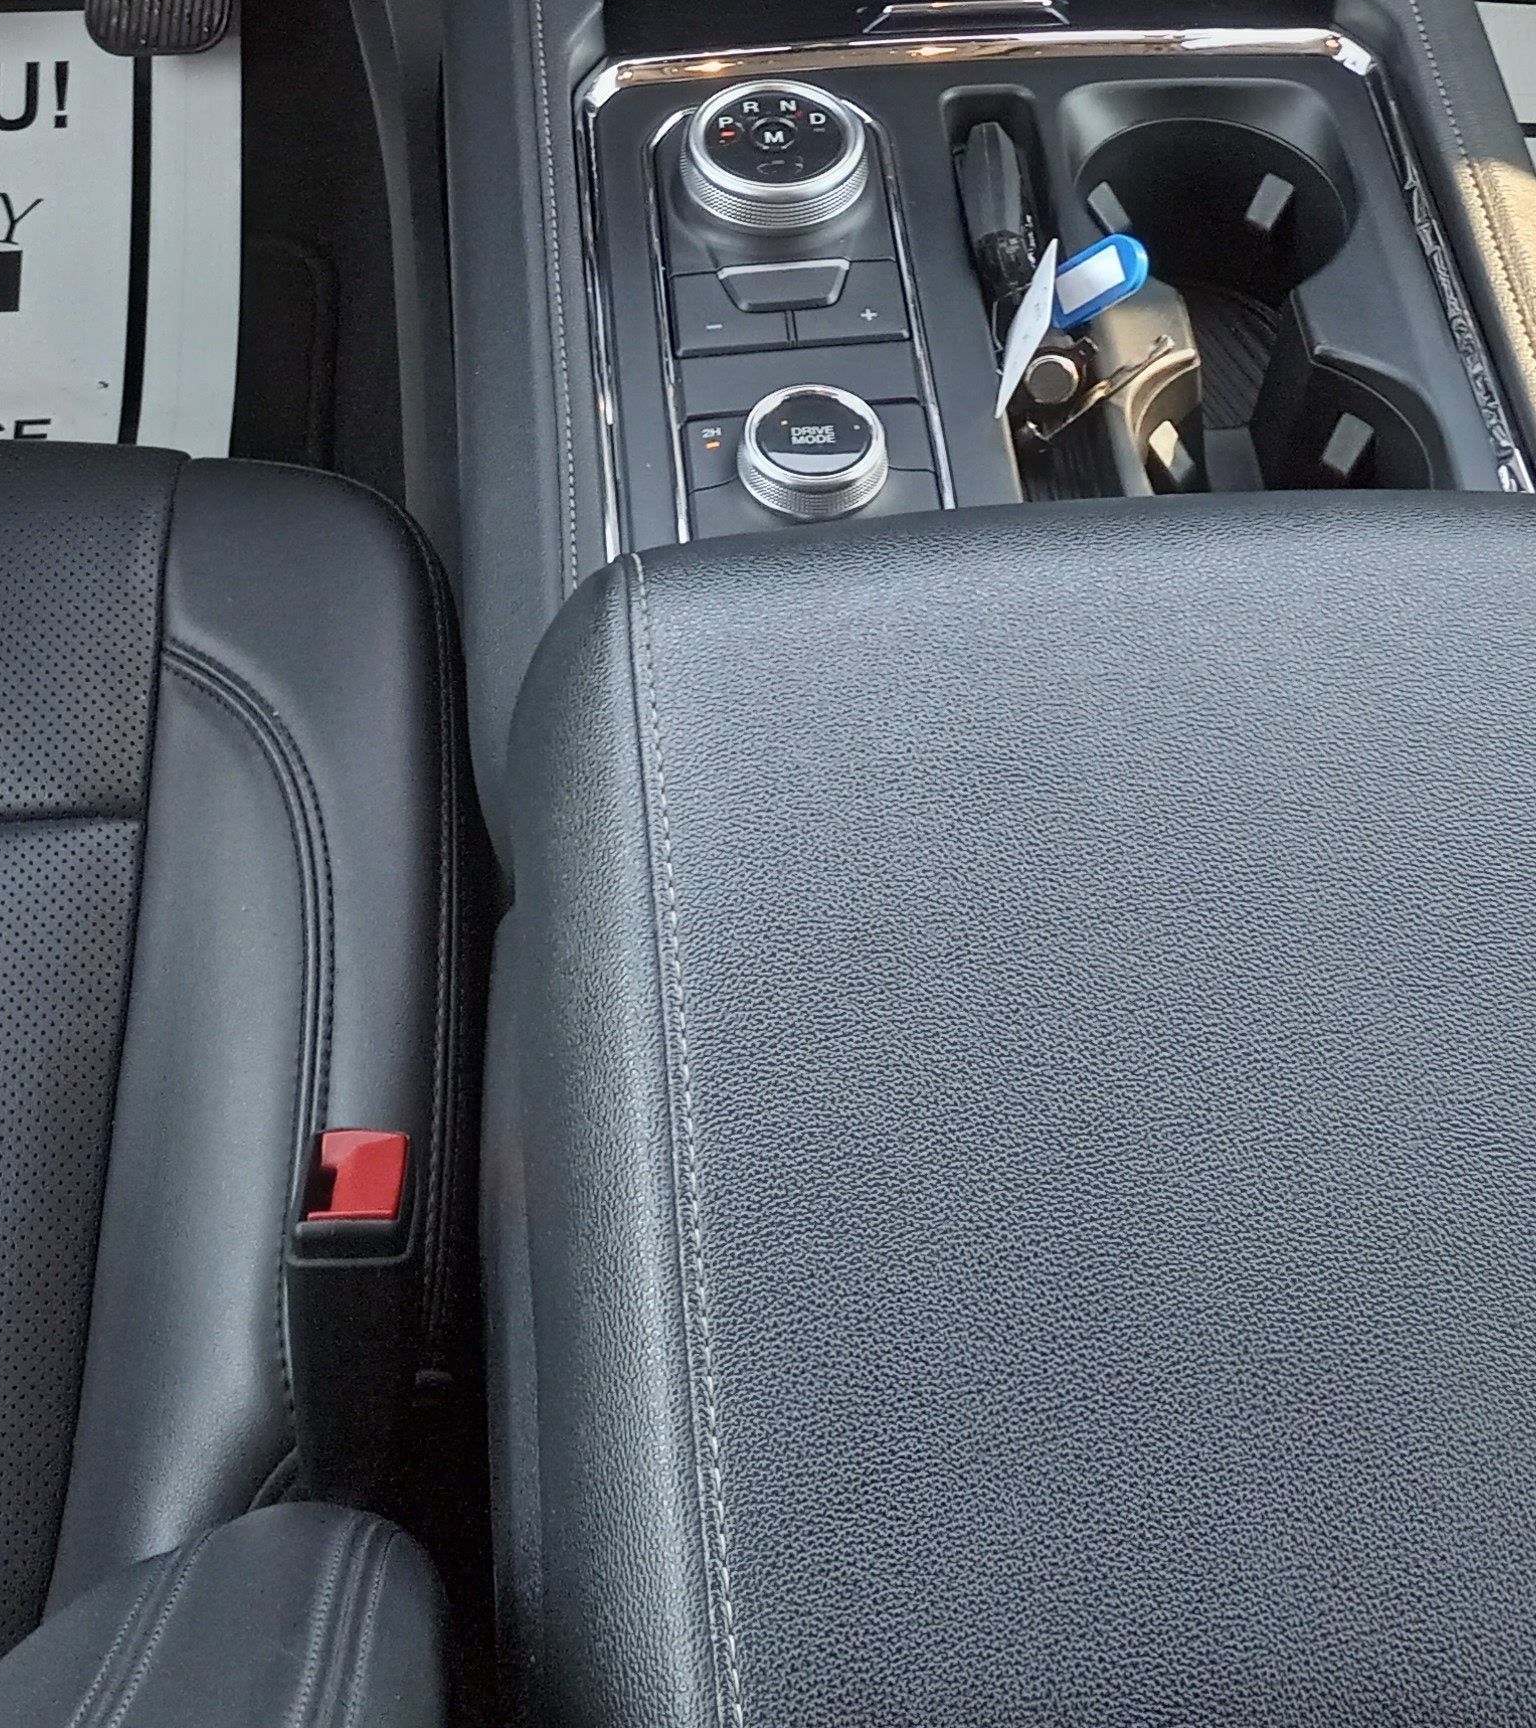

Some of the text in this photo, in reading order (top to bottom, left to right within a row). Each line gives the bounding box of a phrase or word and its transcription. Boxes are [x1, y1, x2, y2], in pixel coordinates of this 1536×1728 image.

[743, 102, 760, 113] R
[780, 101, 797, 112] N
[719, 117, 734, 129] P
[810, 114, 826, 125] D
[764, 131, 784, 143] M
[701, 427, 722, 439] 2H
[790, 425, 835, 436] DRIVE
[791, 434, 837, 445] MODE
